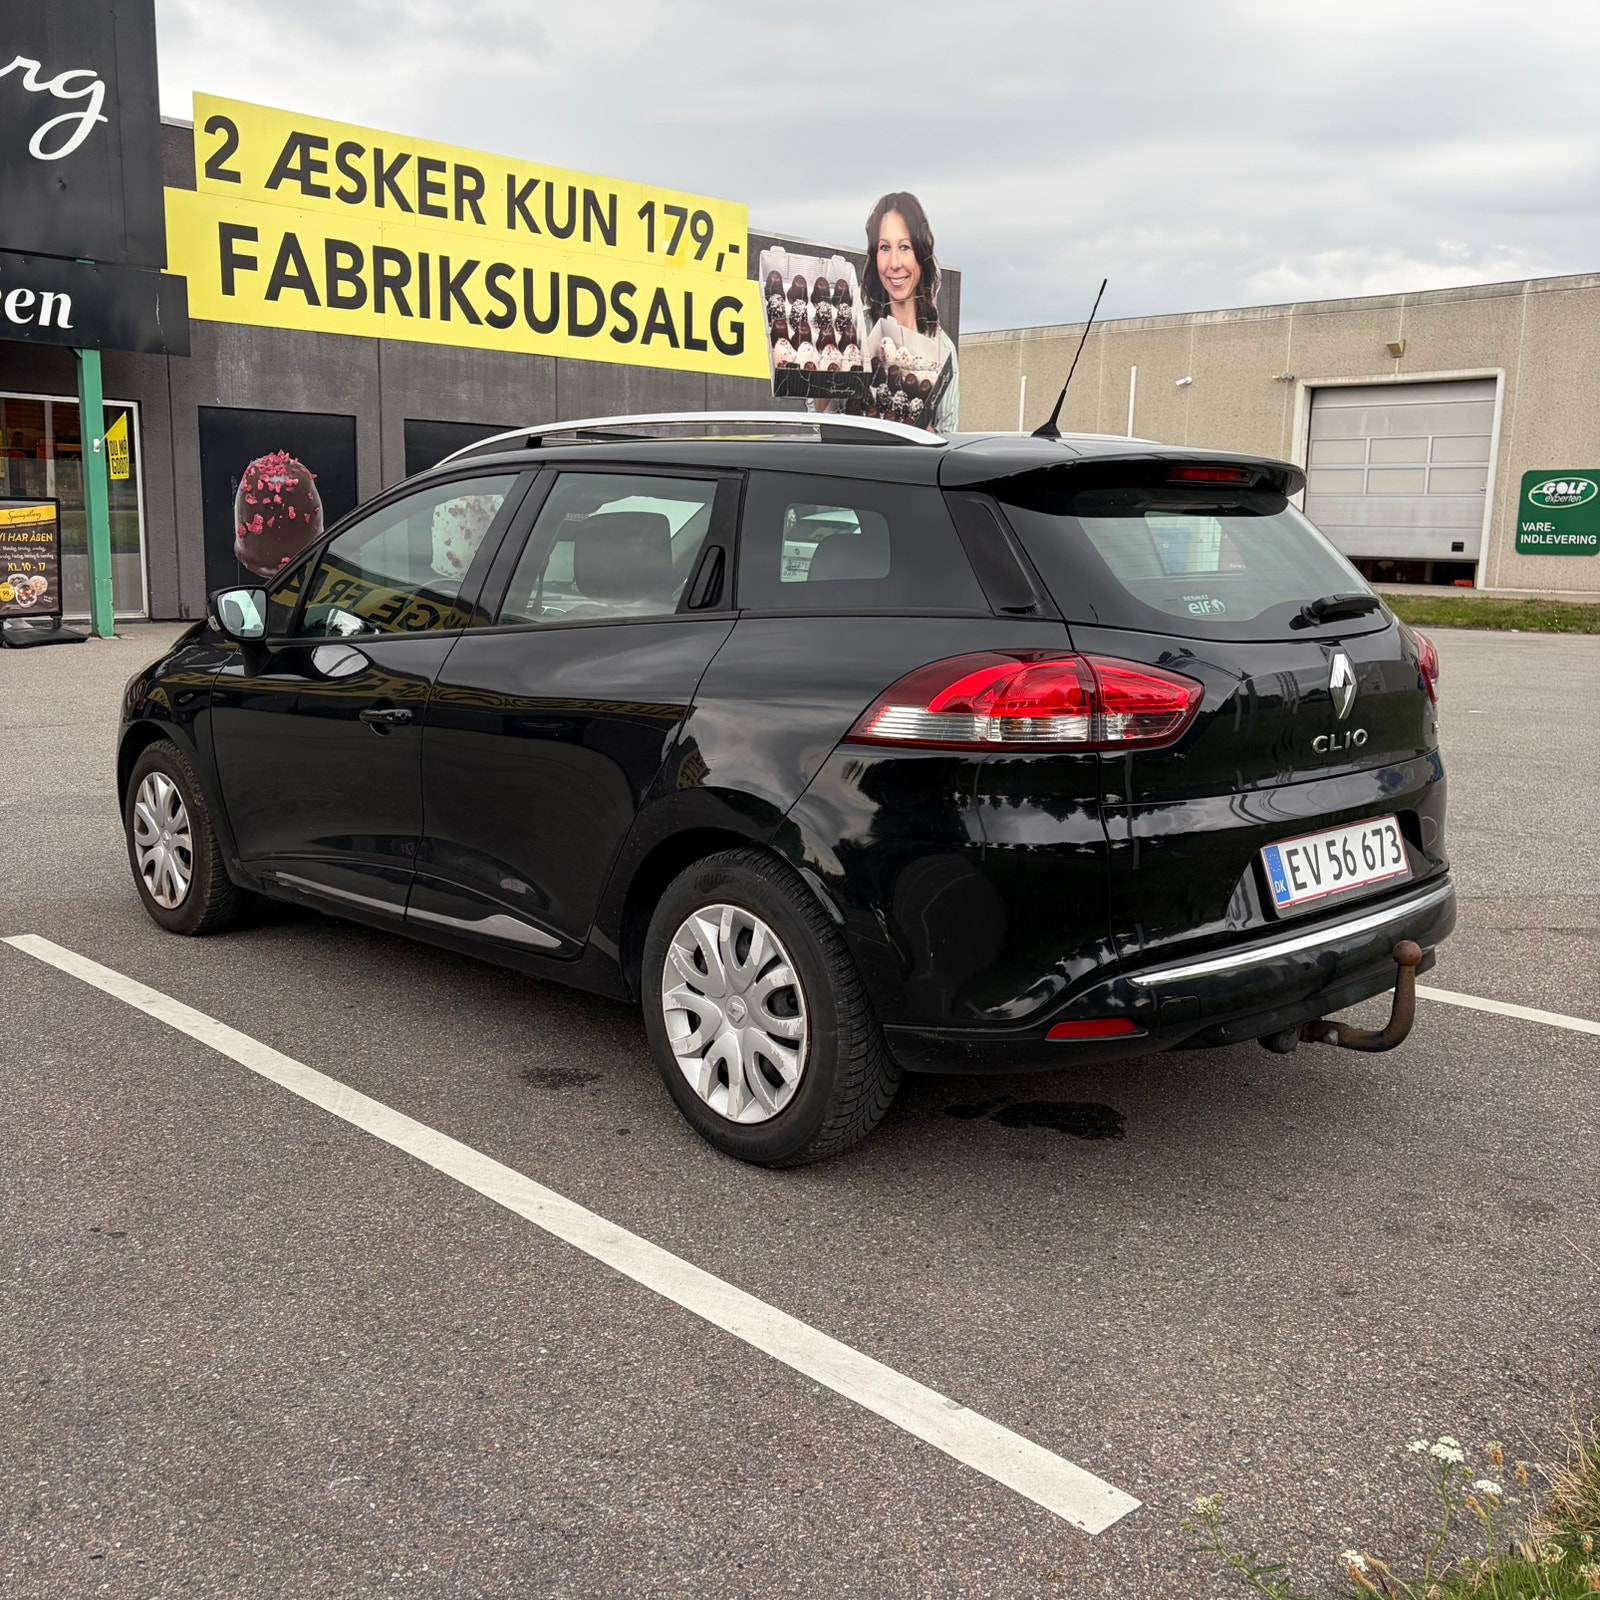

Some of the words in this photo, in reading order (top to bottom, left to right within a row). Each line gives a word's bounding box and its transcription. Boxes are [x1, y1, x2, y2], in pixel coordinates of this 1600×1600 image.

[203, 114, 242, 185] 2
[264, 130, 487, 227] ÆSKER
[506, 173, 618, 247] KUN
[636, 200, 740, 273] 179,-
[217, 221, 745, 356] FABRIKSUDSALG
[0, 288, 74, 329] en
[1542, 482, 1588, 495] GOLF
[1544, 494, 1582, 504] experten
[1521, 522, 1556, 532] VARE-
[7, 533, 29, 542] HAR
[30, 530, 54, 542] ÅBEN
[1520, 534, 1597, 545] INDLEVERING
[21, 562, 31, 571] 10
[38, 562, 46, 571] 17
[1187, 600, 1211, 614] elf
[1312, 728, 1369, 754] CLIO
[1285, 843, 1322, 891] EV
[1325, 836, 1358, 881] 56
[1361, 825, 1402, 871] 673
[1274, 879, 1287, 894] DK
